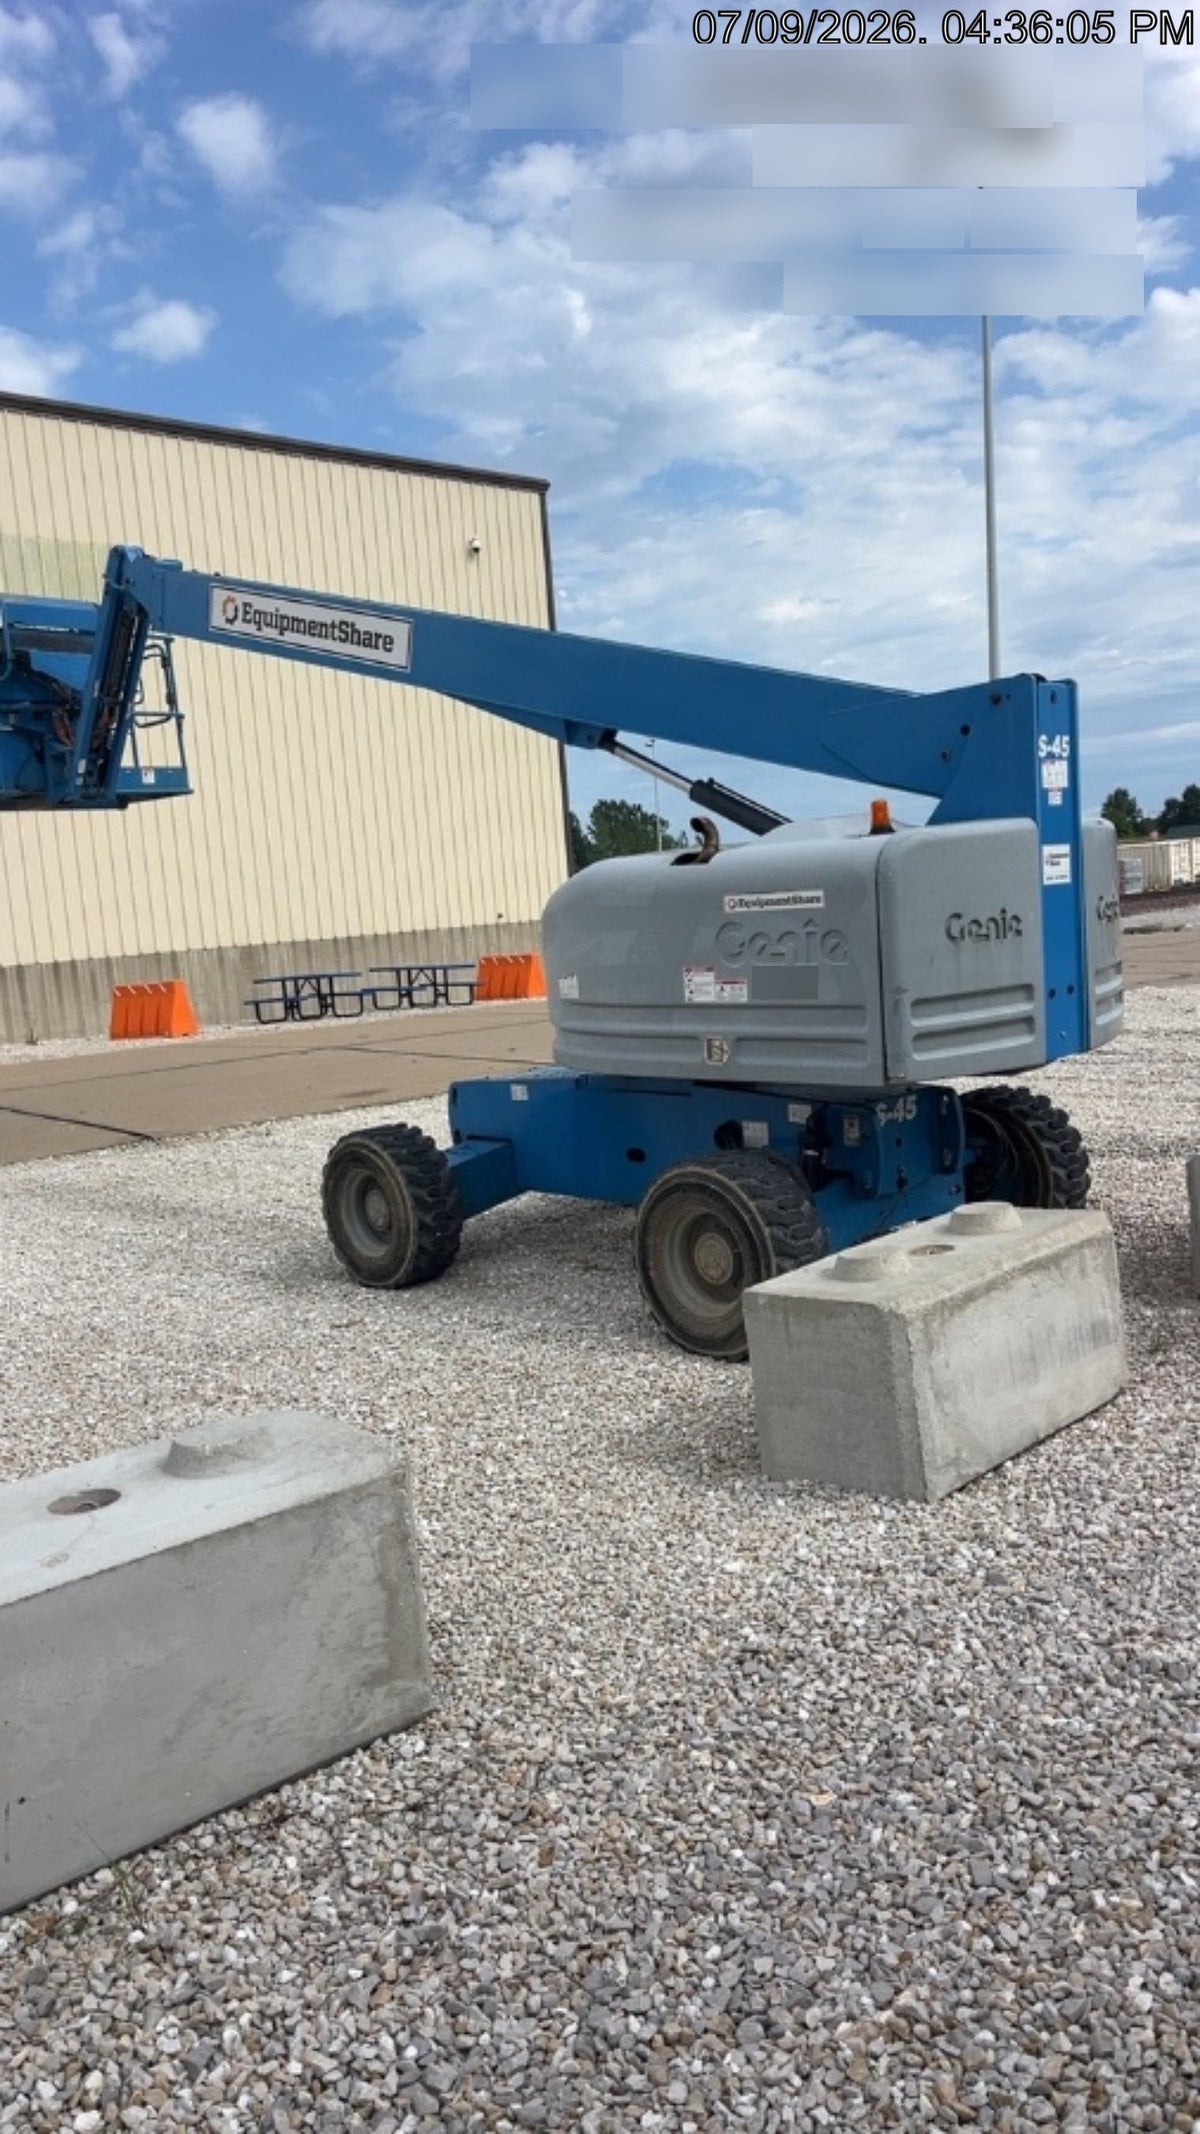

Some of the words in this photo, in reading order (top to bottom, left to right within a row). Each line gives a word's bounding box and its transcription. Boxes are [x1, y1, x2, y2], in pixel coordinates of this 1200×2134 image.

[241, 601, 395, 653] EquipmentShare
[1038, 734, 1071, 758] S-45
[737, 894, 822, 909] EquipmentShare
[945, 907, 1023, 943] Genie
[715, 917, 850, 968] Genie
[874, 1094, 918, 1127] S-45
